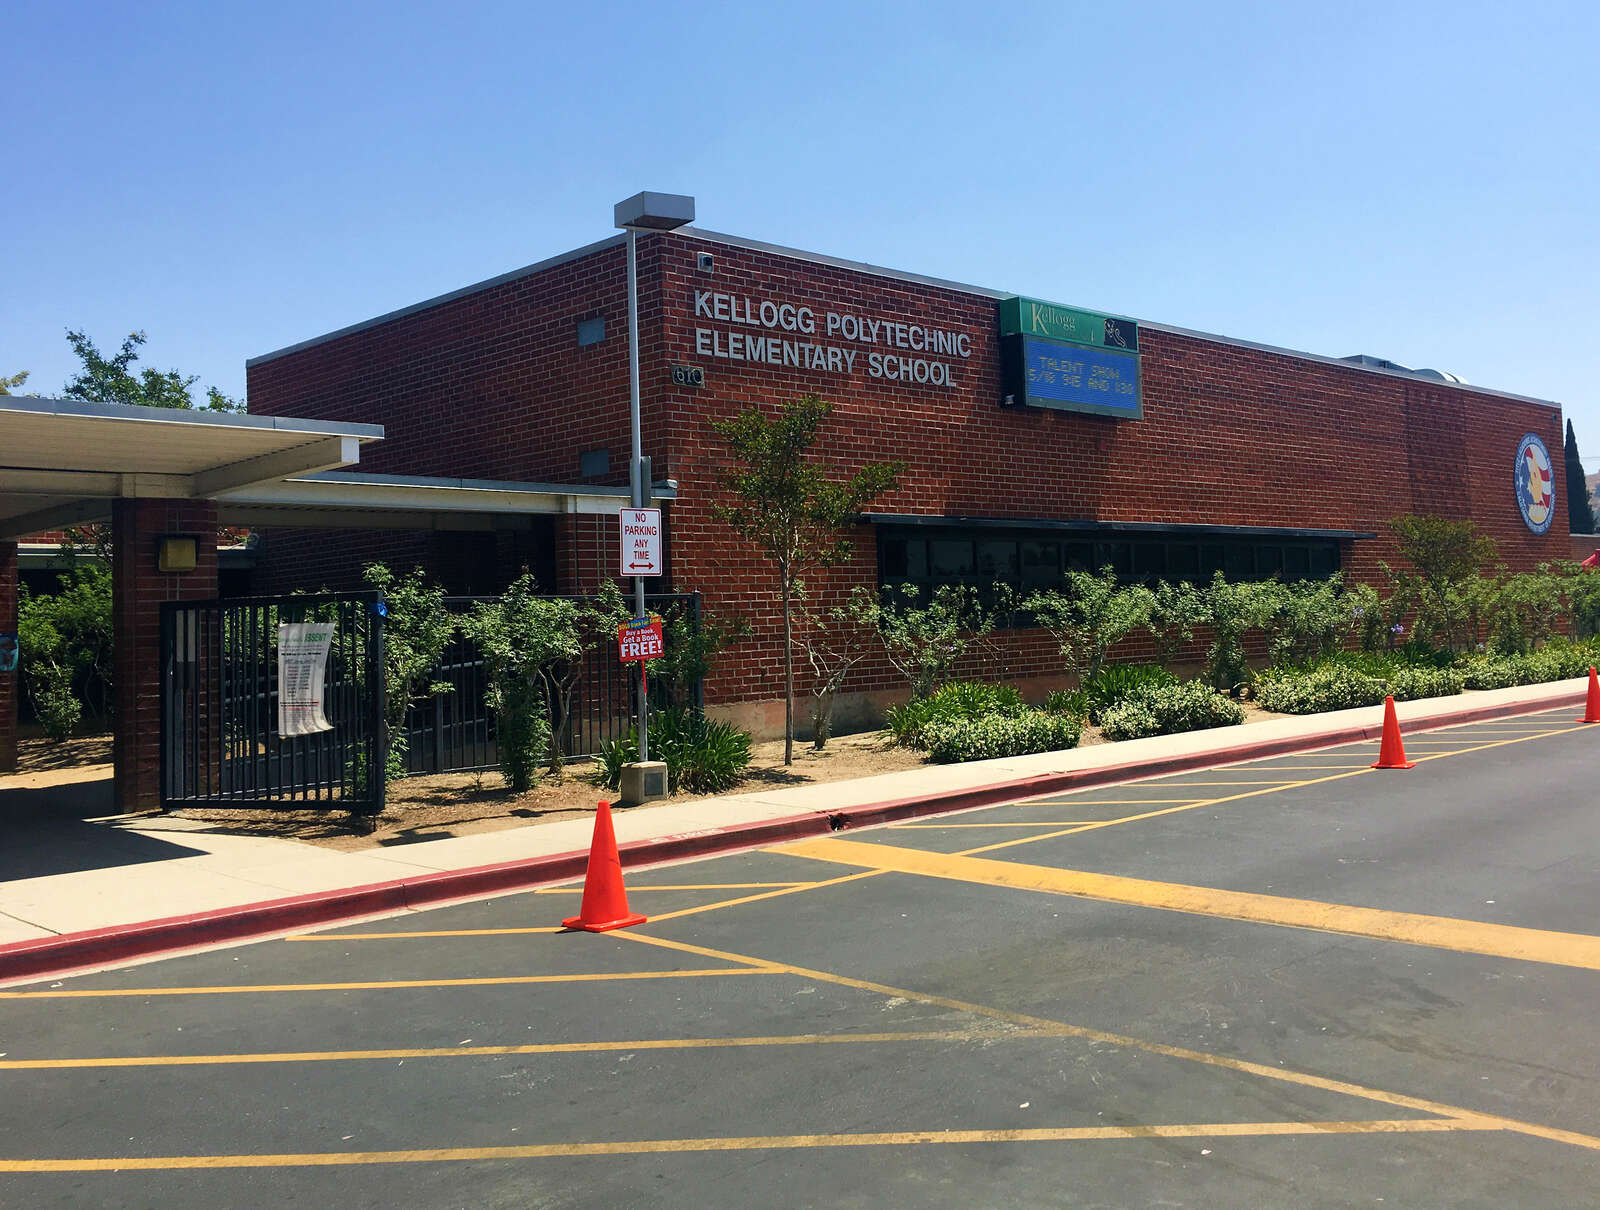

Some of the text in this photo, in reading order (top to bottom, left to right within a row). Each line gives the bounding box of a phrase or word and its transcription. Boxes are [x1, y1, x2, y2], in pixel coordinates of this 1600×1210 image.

[694, 289, 972, 358] KELLOGG POLYTECHNIC
[1031, 303, 1076, 335] Kellogg
[695, 327, 957, 387] ELEMENTARY SCHOOL
[635, 512, 647, 523] NO
[624, 525, 658, 536] PARKING
[634, 539, 649, 548] ANY
[633, 550, 650, 560] TIME
[623, 635, 636, 644] Get
[641, 633, 659, 642] Book
[620, 639, 662, 658] FREE!
